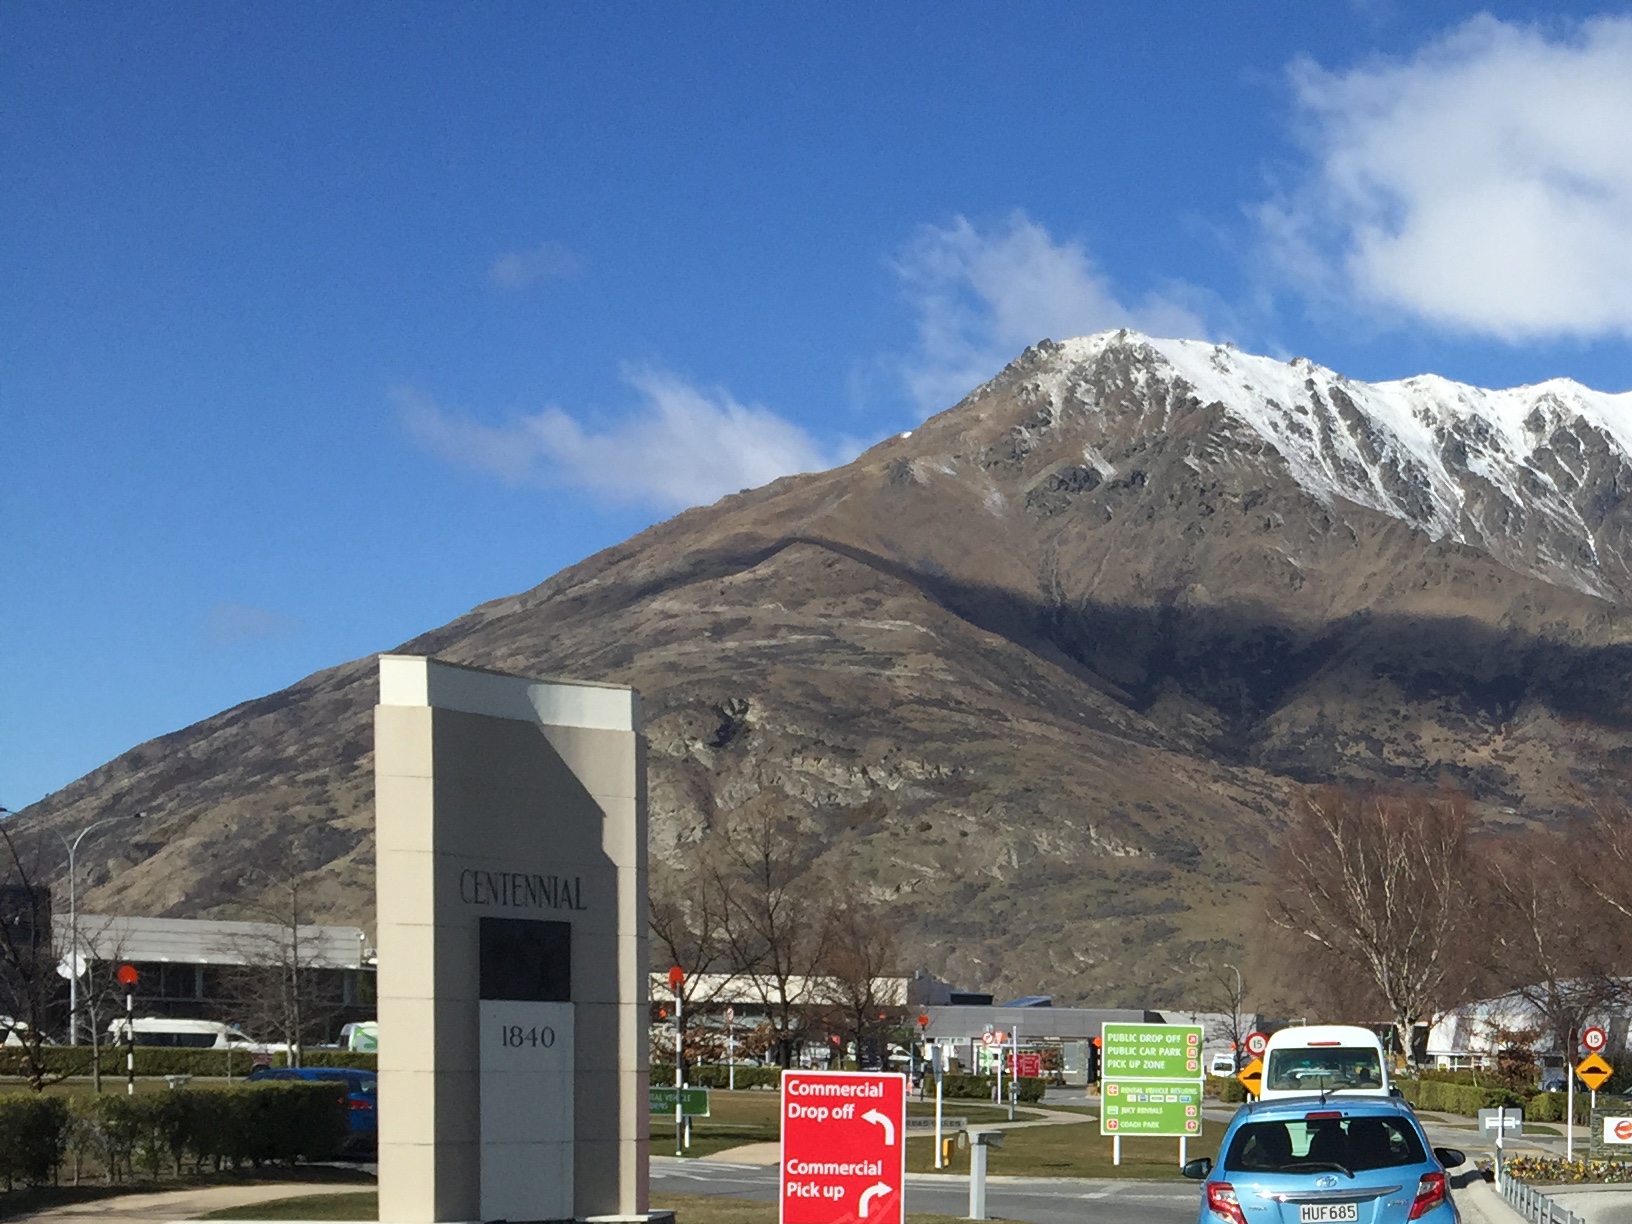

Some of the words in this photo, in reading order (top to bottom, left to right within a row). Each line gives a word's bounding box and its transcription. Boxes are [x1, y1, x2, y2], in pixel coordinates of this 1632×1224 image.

[460, 869, 587, 911] CENTENNIAL
[502, 1025, 556, 1049] 1840
[1107, 1033, 1137, 1043] PUBLIC
[1140, 1034, 1163, 1043] DROP
[1165, 1034, 1182, 1044] OFF
[1253, 1040, 1263, 1049] 15
[1590, 1034, 1600, 1044] 15
[1107, 1046, 1137, 1056] PUBLIC
[1139, 1046, 1157, 1056] CAR
[1159, 1047, 1181, 1057] PARK
[1107, 1059, 1127, 1069] PICK
[1129, 1060, 1141, 1069] UP
[1143, 1060, 1165, 1070] ZONE
[787, 1079, 884, 1098] Commercial
[788, 1103, 829, 1122] Drop
[832, 1103, 856, 1119] off
[1142, 1121, 1160, 1129] PARK
[786, 1159, 882, 1176] Commercial
[786, 1181, 820, 1198] Pick
[823, 1185, 845, 1201] up
[1302, 1205, 1356, 1221] HUF685
